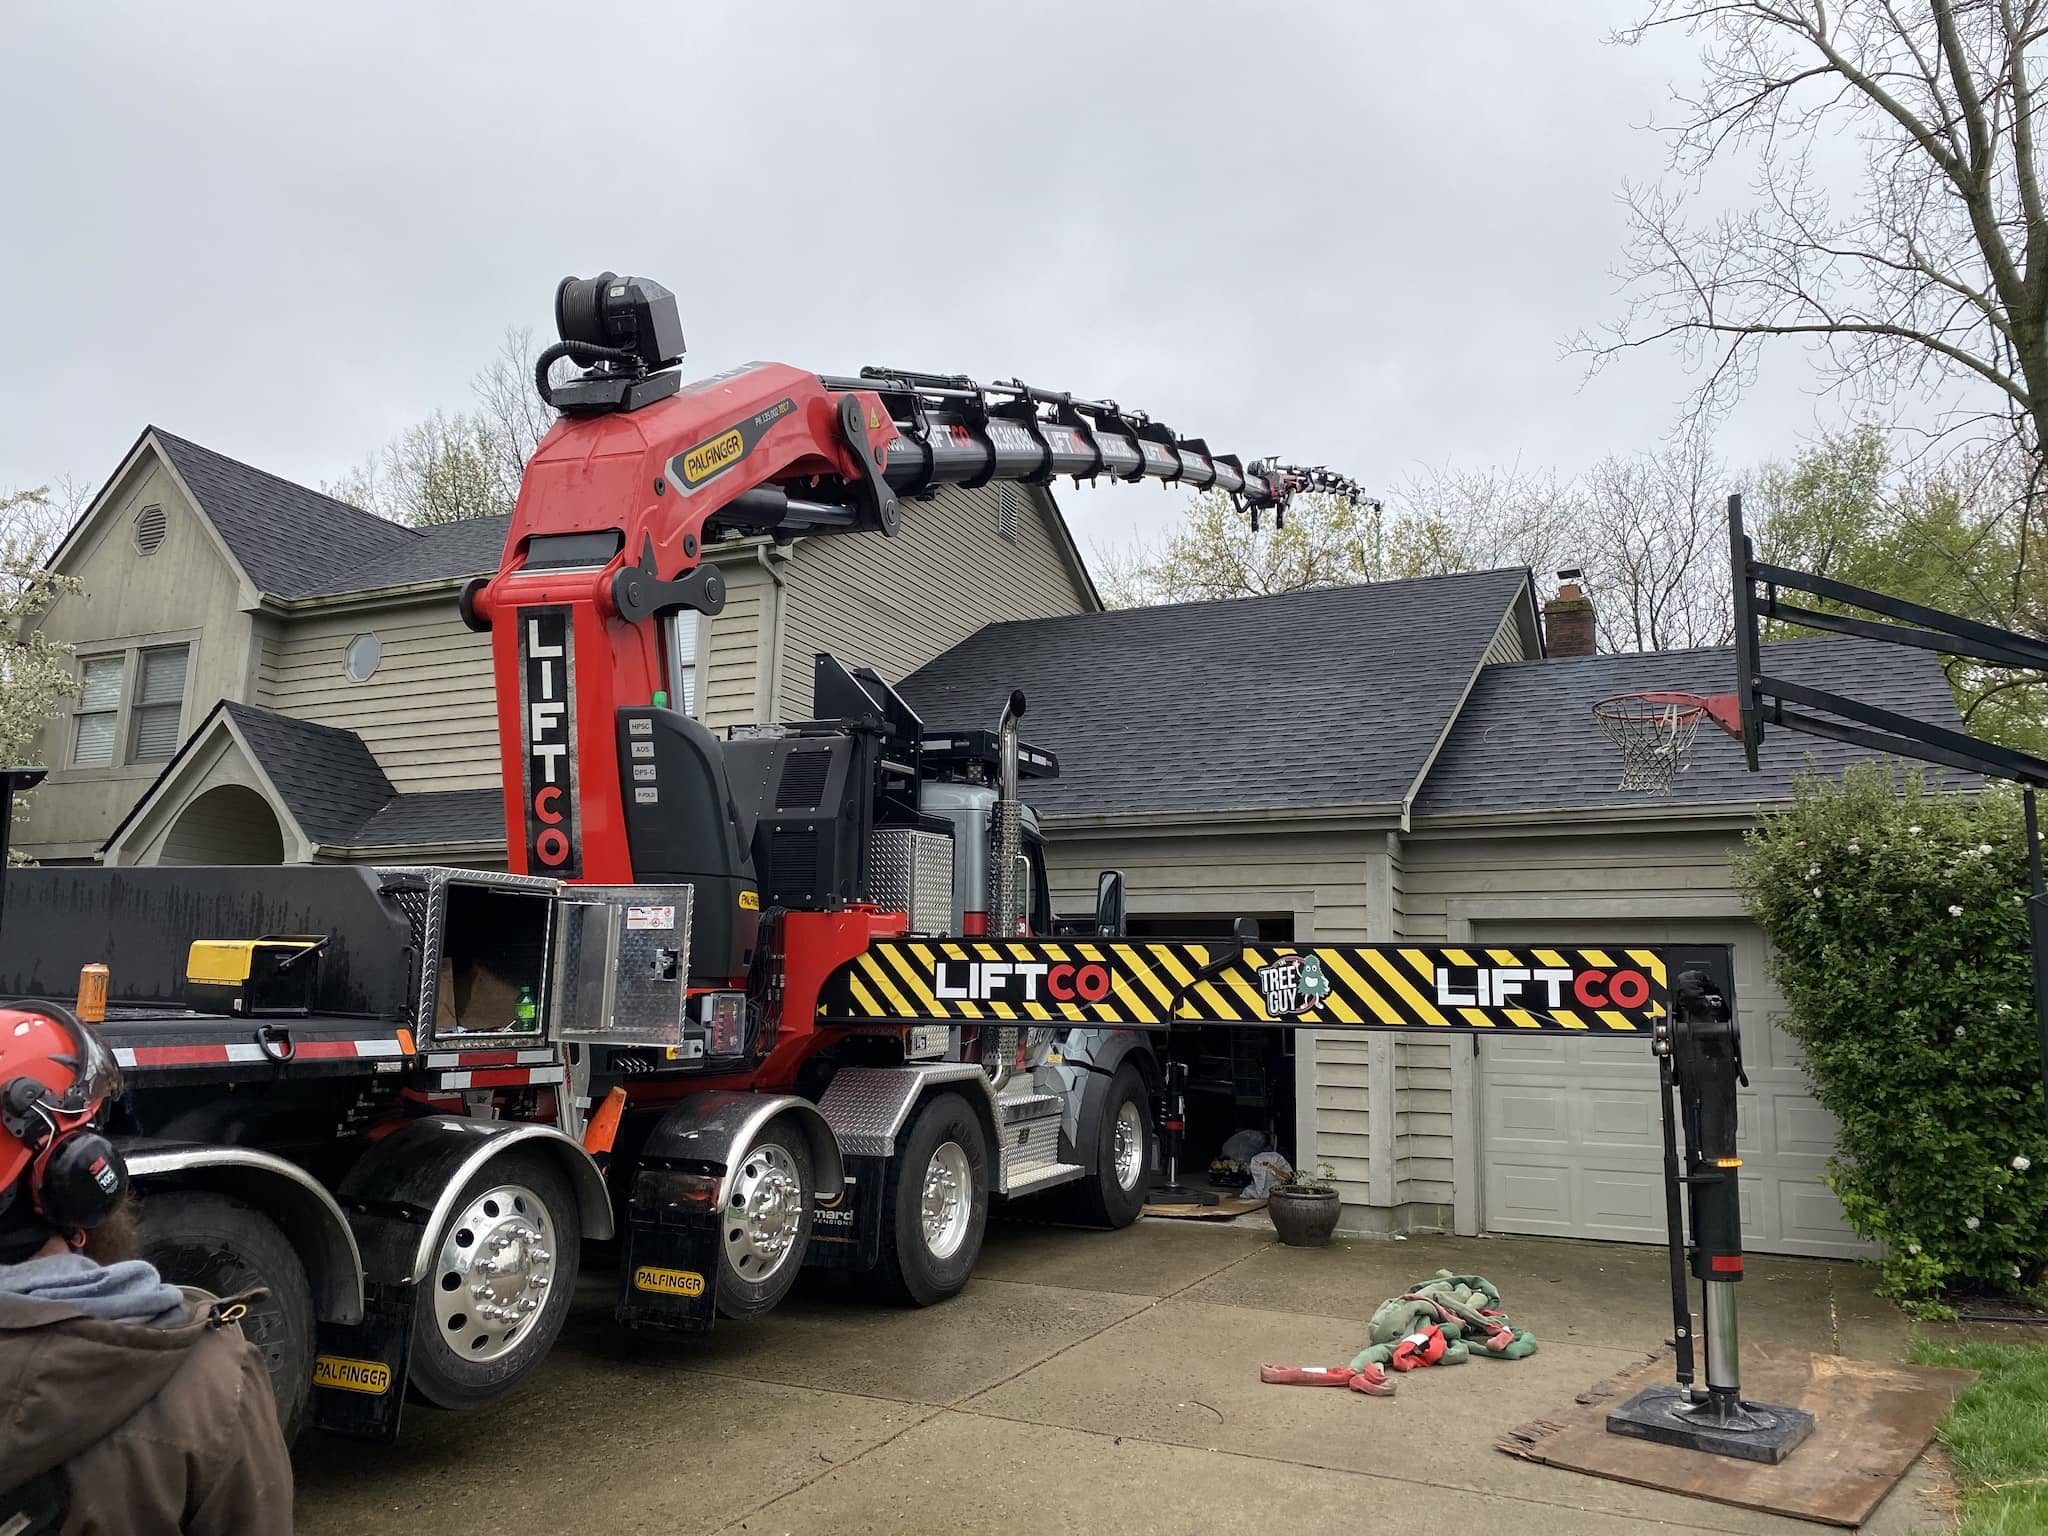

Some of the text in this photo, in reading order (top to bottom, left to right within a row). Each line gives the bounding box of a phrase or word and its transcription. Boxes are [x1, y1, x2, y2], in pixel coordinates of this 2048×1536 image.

[688, 435, 740, 477] PALFINGER
[528, 619, 569, 866] LIFTCO
[935, 962, 1110, 1001] LIFTCO
[1260, 965, 1297, 992] TREE
[1436, 967, 1650, 1009] LIFTCO
[1269, 988, 1297, 1014] GUY
[637, 1271, 701, 1291] PALFINGER
[314, 1362, 387, 1387] PALFINGER
